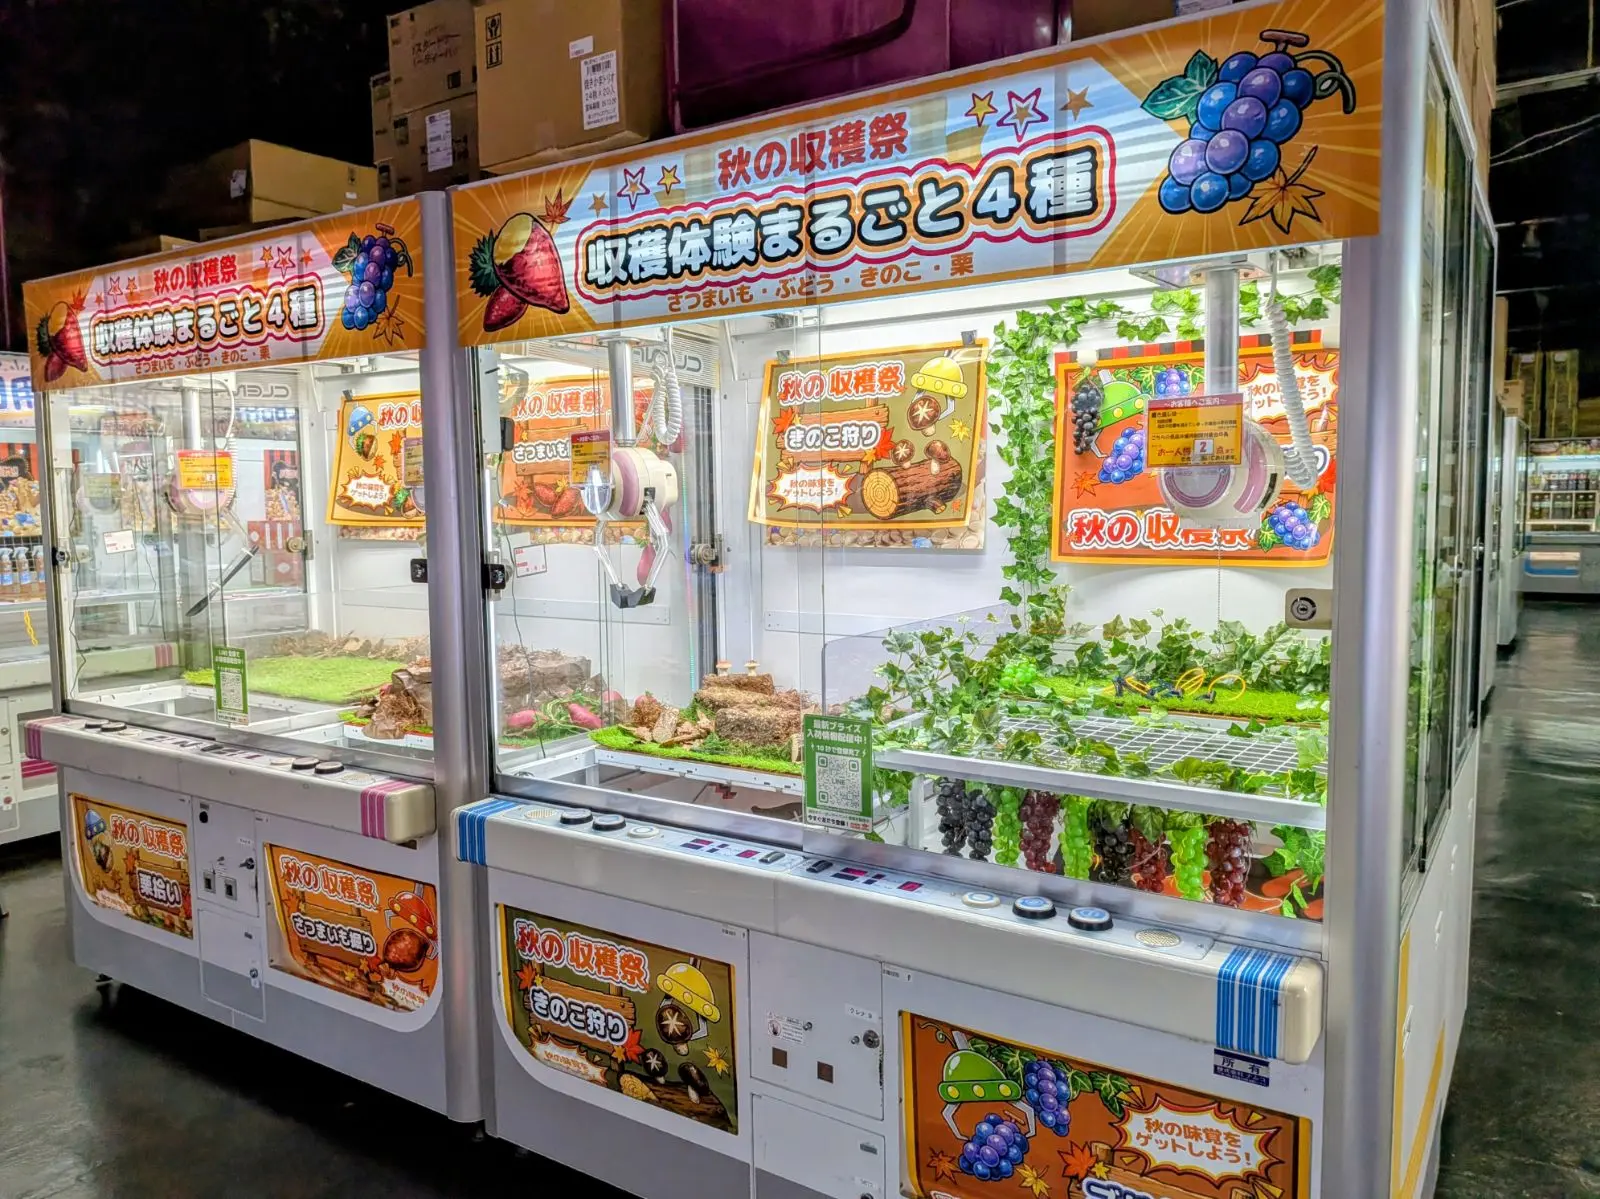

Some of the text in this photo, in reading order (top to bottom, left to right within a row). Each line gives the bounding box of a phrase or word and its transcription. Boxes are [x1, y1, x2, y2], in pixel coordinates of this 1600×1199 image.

[717, 110, 909, 190] 秋の収穫祭
[585, 147, 1099, 288] 収穫体験まるごと4種
[153, 255, 239, 296] 秋の収穫祭
[94, 286, 319, 356] 収穫体験まるごと4種
[779, 365, 905, 402] 秋の収穫祭
[787, 423, 877, 450] きのこ狩り
[1199, 441, 1207, 453] 2
[831, 777, 846, 785] LINE
[111, 818, 185, 858] 秋の収穫祭
[139, 873, 181, 905] 栗拾い
[282, 859, 377, 907] 秋の収穫祭
[293, 915, 376, 954] さつまいも掘り
[515, 922, 650, 991] 秋の収穫祭
[531, 990, 627, 1042] きのこ狩り
[1221, 1056, 1262, 1074] 所有
[1135, 1131, 1252, 1167] ゲットしよう!
[1143, 1116, 1243, 1149] 秋の味覚を
